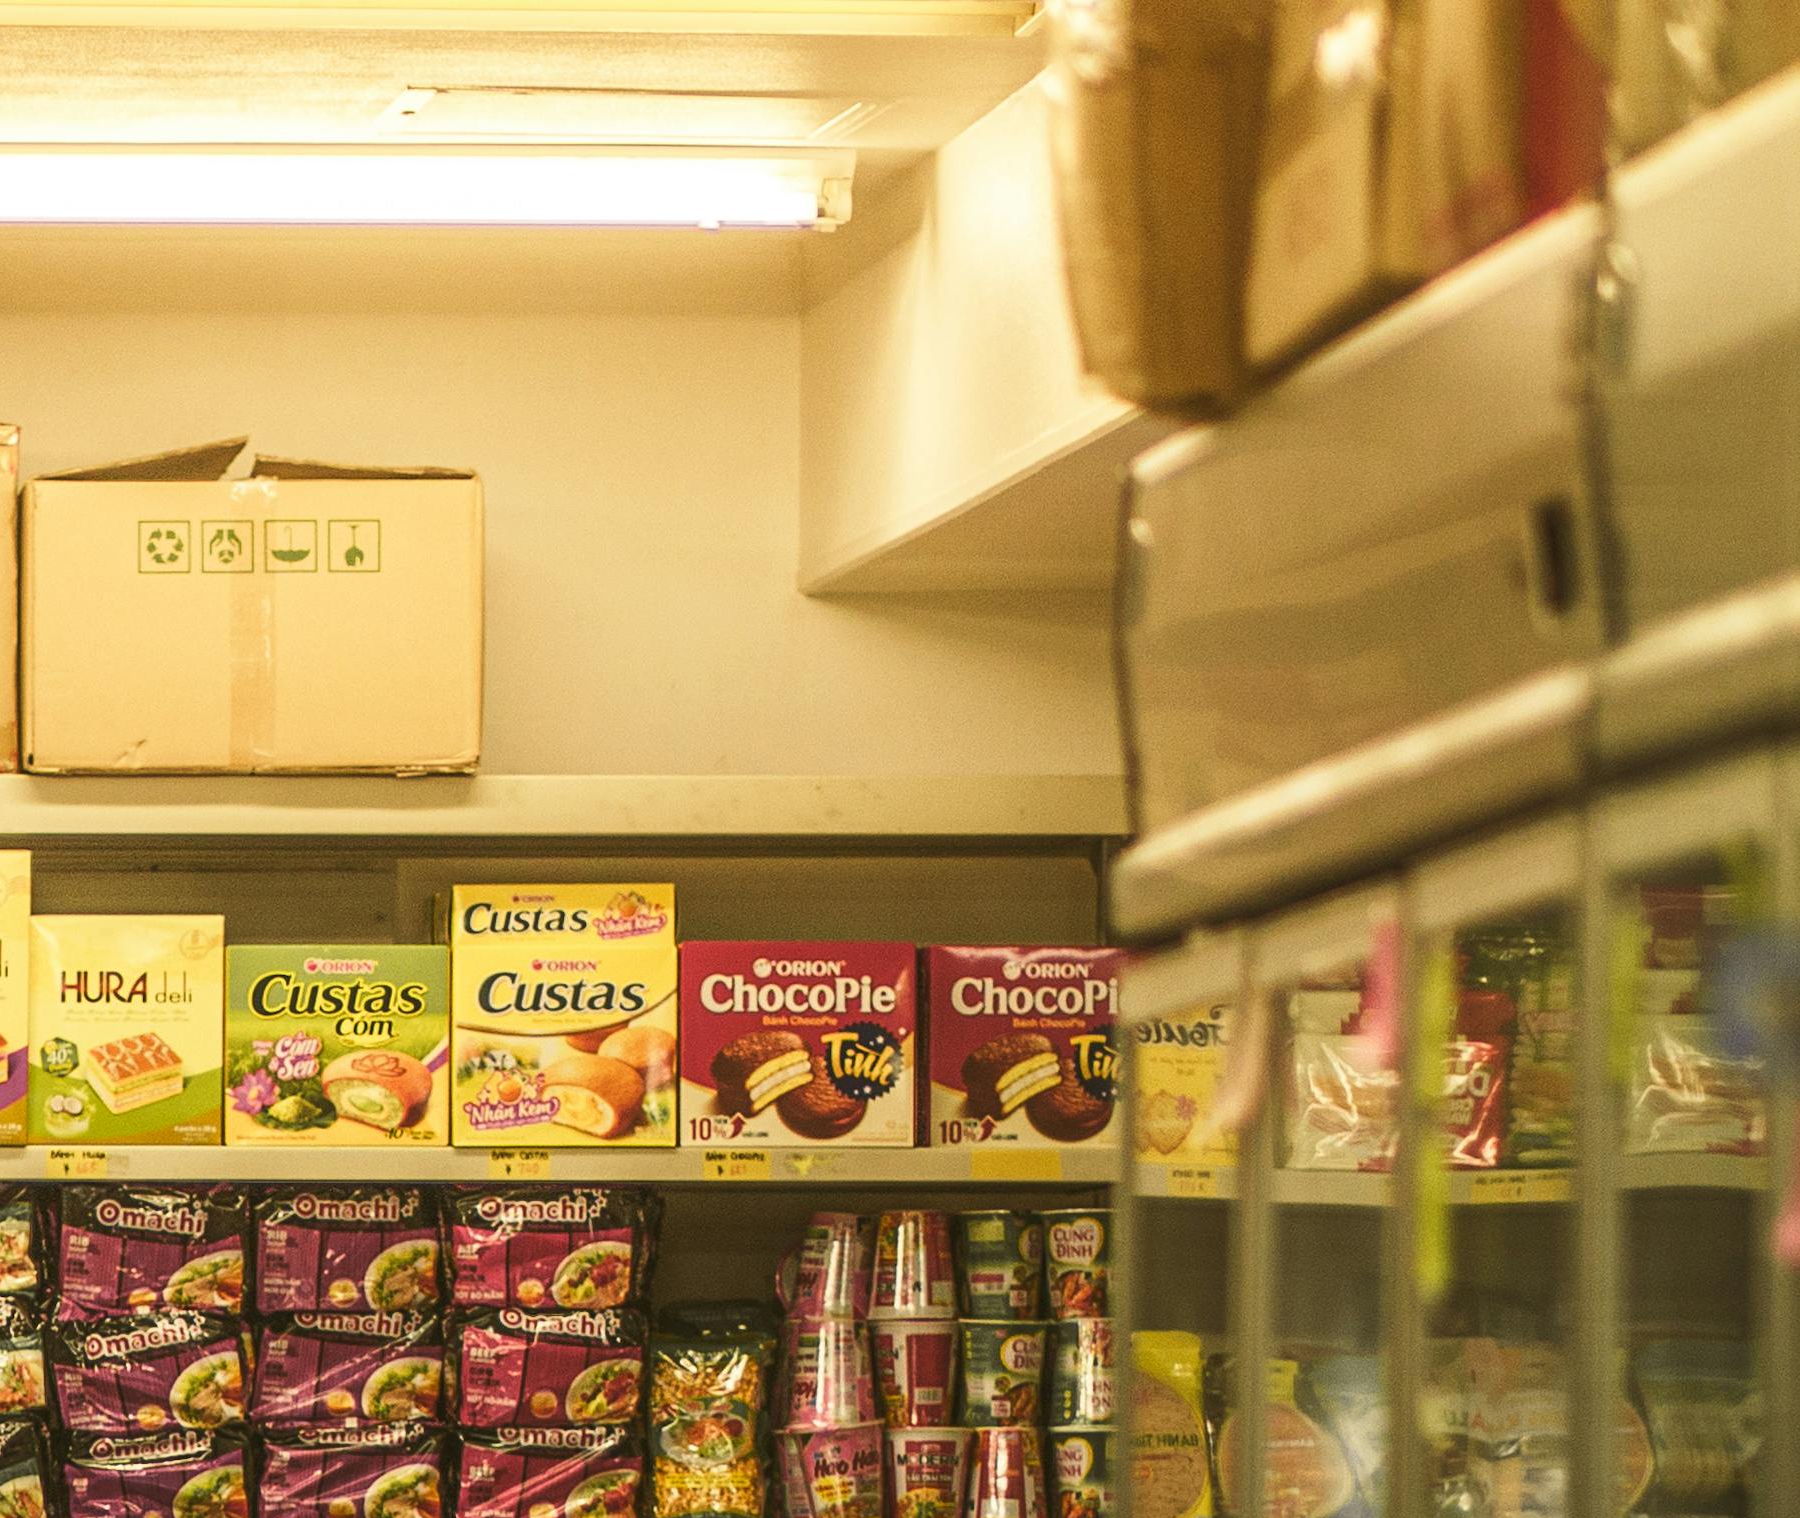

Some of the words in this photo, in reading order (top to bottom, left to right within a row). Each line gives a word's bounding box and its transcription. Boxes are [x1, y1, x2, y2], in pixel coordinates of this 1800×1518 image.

[462, 901, 589, 936] Custas
[321, 958, 376, 974] ORION
[545, 957, 600, 973] ORION
[774, 960, 843, 977] ORION
[1026, 960, 1094, 978] ORION
[59, 970, 149, 1005] HURA
[154, 972, 194, 1004] deli
[246, 971, 427, 1018] Custas
[476, 970, 647, 1015] Custas
[699, 975, 897, 1015] ChocoPie
[949, 977, 1119, 1017] ChocoPi
[761, 1014, 789, 1027] Bánh
[790, 1014, 838, 1027] ChocoPie
[1012, 1017, 1038, 1029] Bánh
[1040, 1017, 1087, 1029] ChocoPie
[95, 1198, 207, 1236] Omachi
[293, 1194, 401, 1223] Omachi
[476, 1196, 588, 1223] Omachi
[1052, 1227, 1095, 1245] CUNG
[294, 1308, 403, 1338] Omachi
[498, 1306, 608, 1339] Omachi
[83, 1320, 191, 1361] Omachi
[91, 1431, 198, 1460] Omachi
